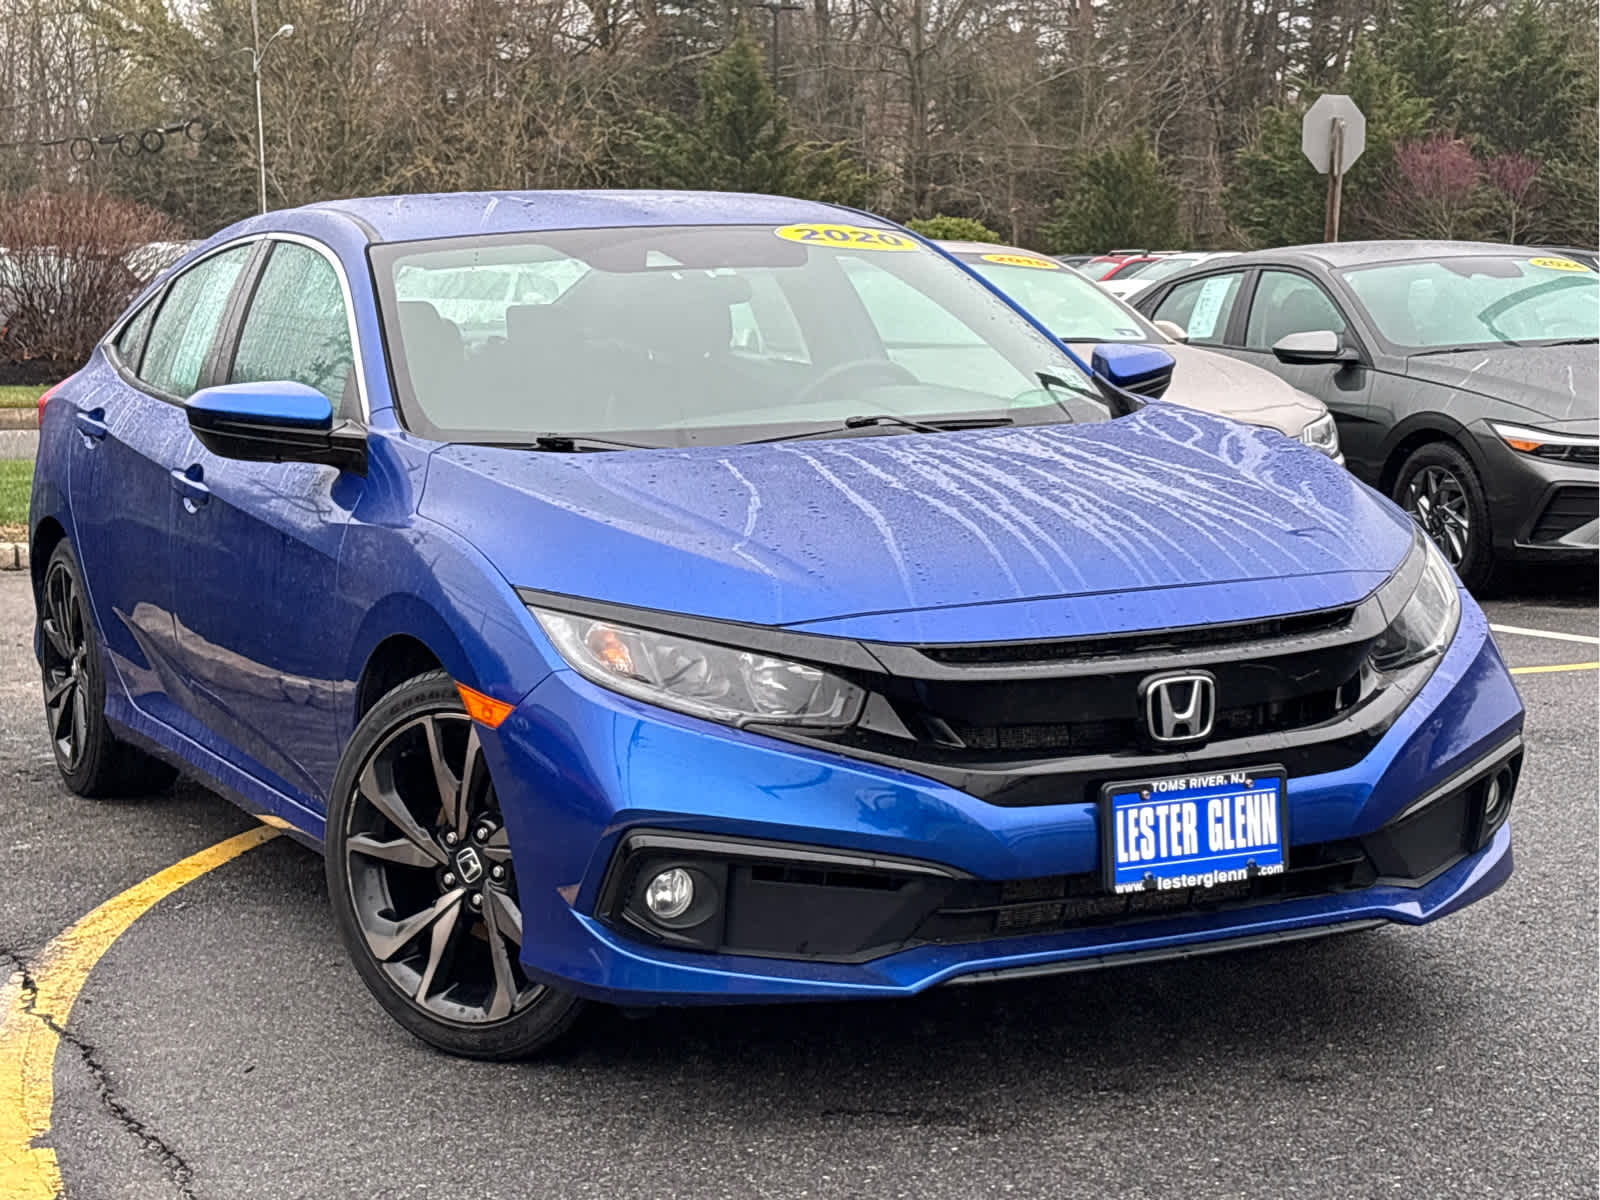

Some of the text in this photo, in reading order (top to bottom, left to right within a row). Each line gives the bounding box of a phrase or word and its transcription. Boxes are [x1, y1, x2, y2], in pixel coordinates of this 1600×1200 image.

[793, 228, 904, 246] 2020
[1152, 778, 1186, 793] TOMS
[1230, 773, 1246, 784] NJ
[1116, 792, 1278, 863] LESTER GLENN
[1157, 868, 1247, 890] lesterglenn
[1257, 864, 1284, 876] .com
